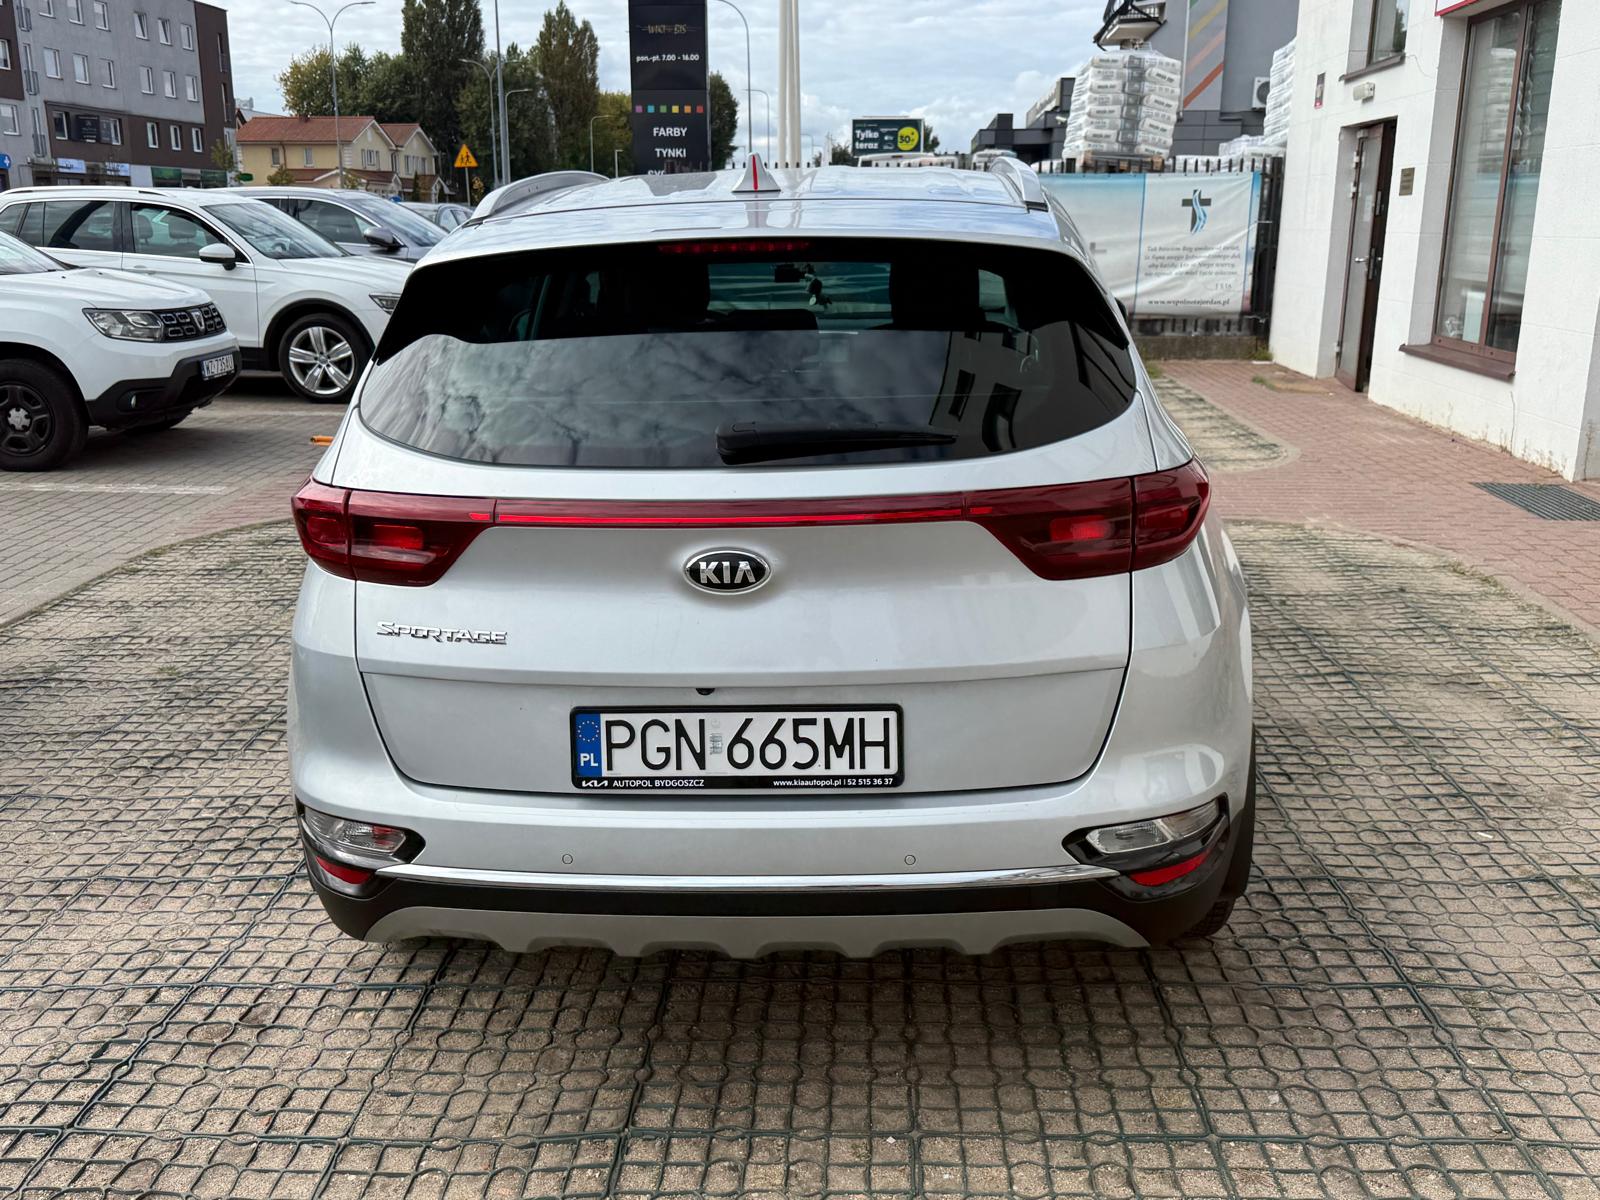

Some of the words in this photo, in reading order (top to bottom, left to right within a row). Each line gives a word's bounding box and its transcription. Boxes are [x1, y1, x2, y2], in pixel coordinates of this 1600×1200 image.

[653, 127, 687, 137] FARBY
[855, 130, 879, 140] Tylko
[855, 142, 879, 150] teraz
[655, 148, 687, 158] TYNKI
[699, 561, 756, 584] KIA
[376, 620, 508, 646] SPORTAGE
[605, 718, 706, 771] PGN
[726, 717, 891, 770] 665MH
[580, 753, 598, 767] PL
[613, 779, 653, 788] AUTOPOL
[655, 779, 705, 787] BYDGOSZCZ
[773, 778, 842, 787] www.kiaautopol.pl
[848, 778, 856, 786] 52
[858, 778, 871, 786] 515
[873, 778, 882, 786] 36
